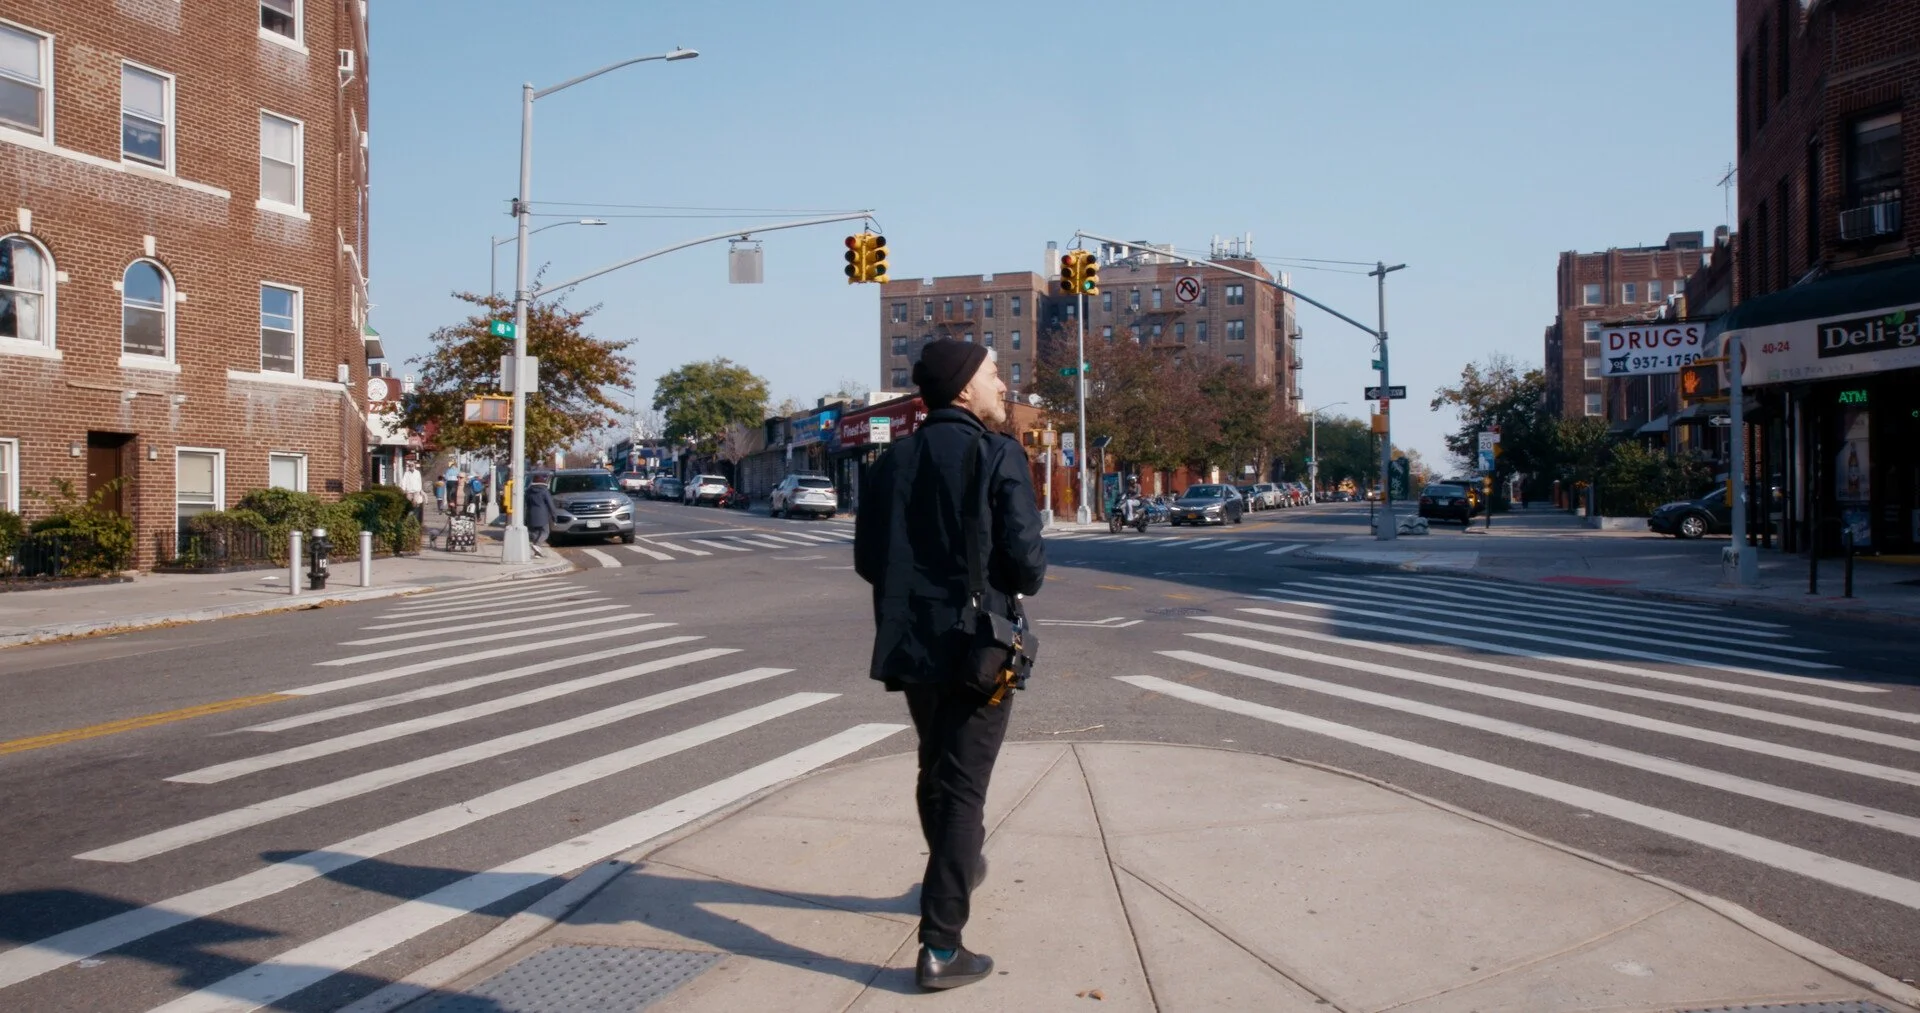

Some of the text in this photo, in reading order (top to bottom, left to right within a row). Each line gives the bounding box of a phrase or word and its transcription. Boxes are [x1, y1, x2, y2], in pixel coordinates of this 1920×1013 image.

[1609, 327, 1698, 350] DRUGS
[1762, 341, 1791, 354] 40-24
[1633, 353, 1701, 369] 937-1750
[1838, 389, 1868, 403] ATM
